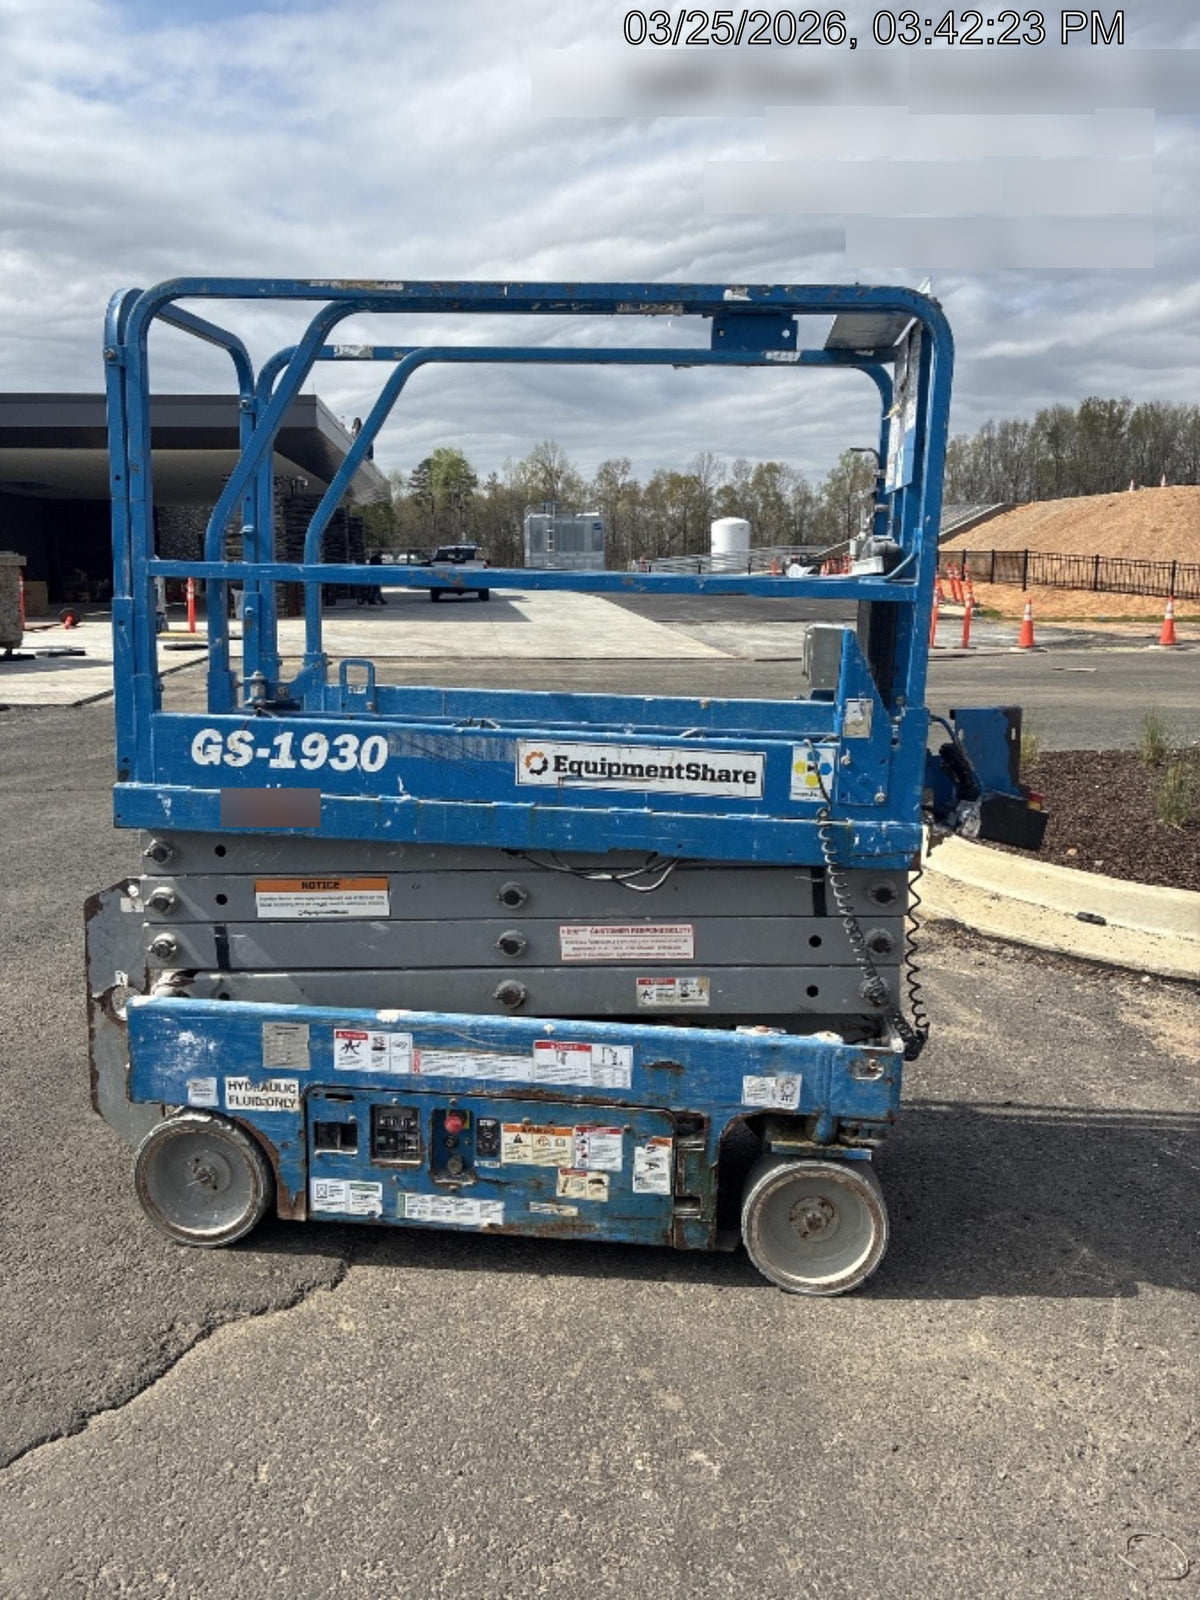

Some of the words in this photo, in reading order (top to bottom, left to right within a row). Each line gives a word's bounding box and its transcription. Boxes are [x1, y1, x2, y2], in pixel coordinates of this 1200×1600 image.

[191, 728, 389, 773] GS-1930
[552, 755, 758, 785] EquipmentShare
[301, 881, 341, 890] NOTICE
[228, 1080, 297, 1094] HYDRAULIC
[229, 1095, 261, 1106] FLUID
[266, 1097, 297, 1109] ONLY
